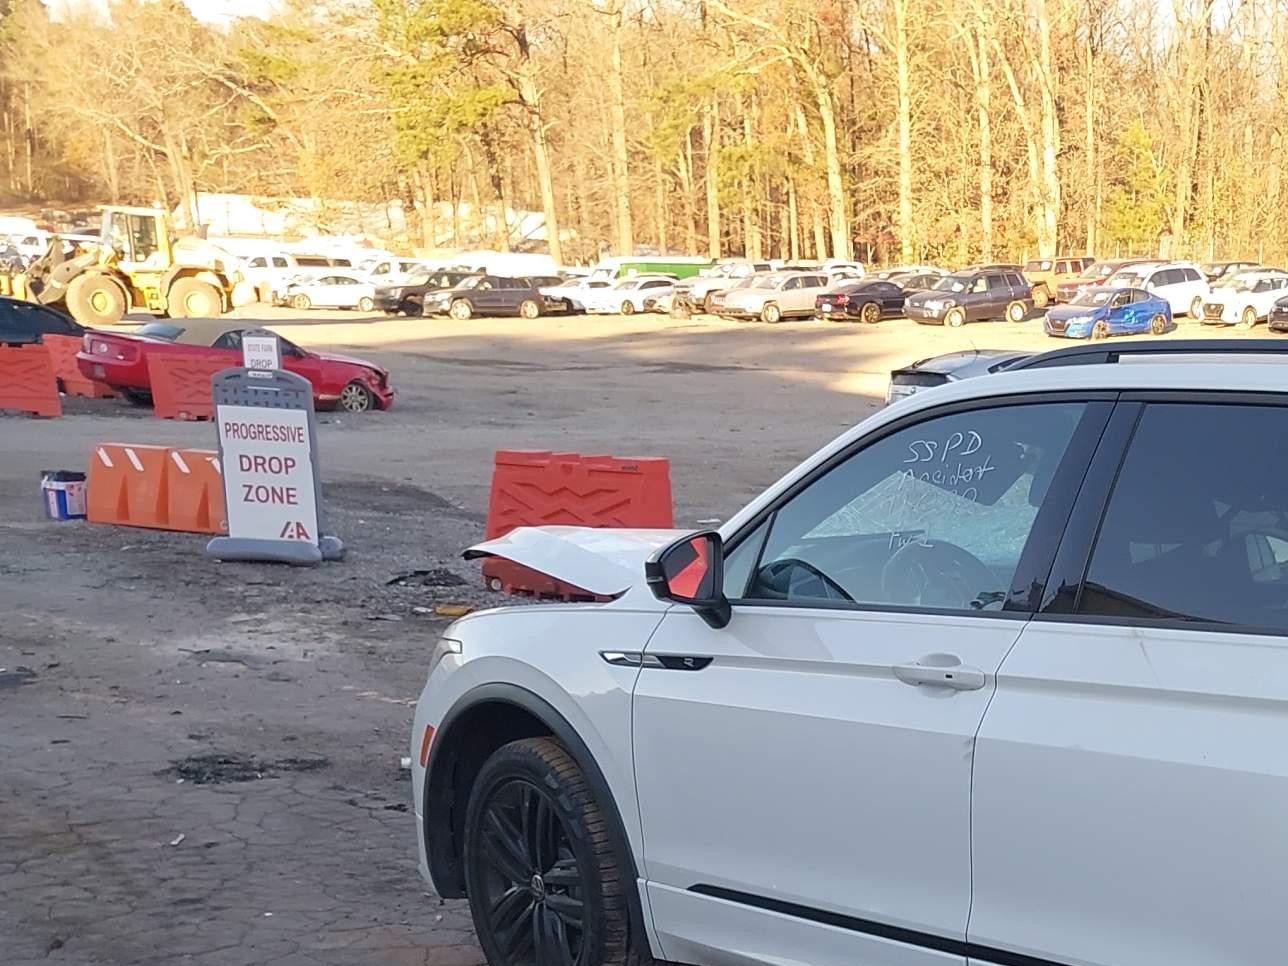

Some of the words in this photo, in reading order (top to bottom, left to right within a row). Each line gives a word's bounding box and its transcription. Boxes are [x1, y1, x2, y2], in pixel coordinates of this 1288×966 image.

[250, 359, 273, 369] DROP
[224, 422, 305, 443] PROGRESSIVE
[239, 454, 297, 475] DROP
[242, 484, 299, 505] ZONE
